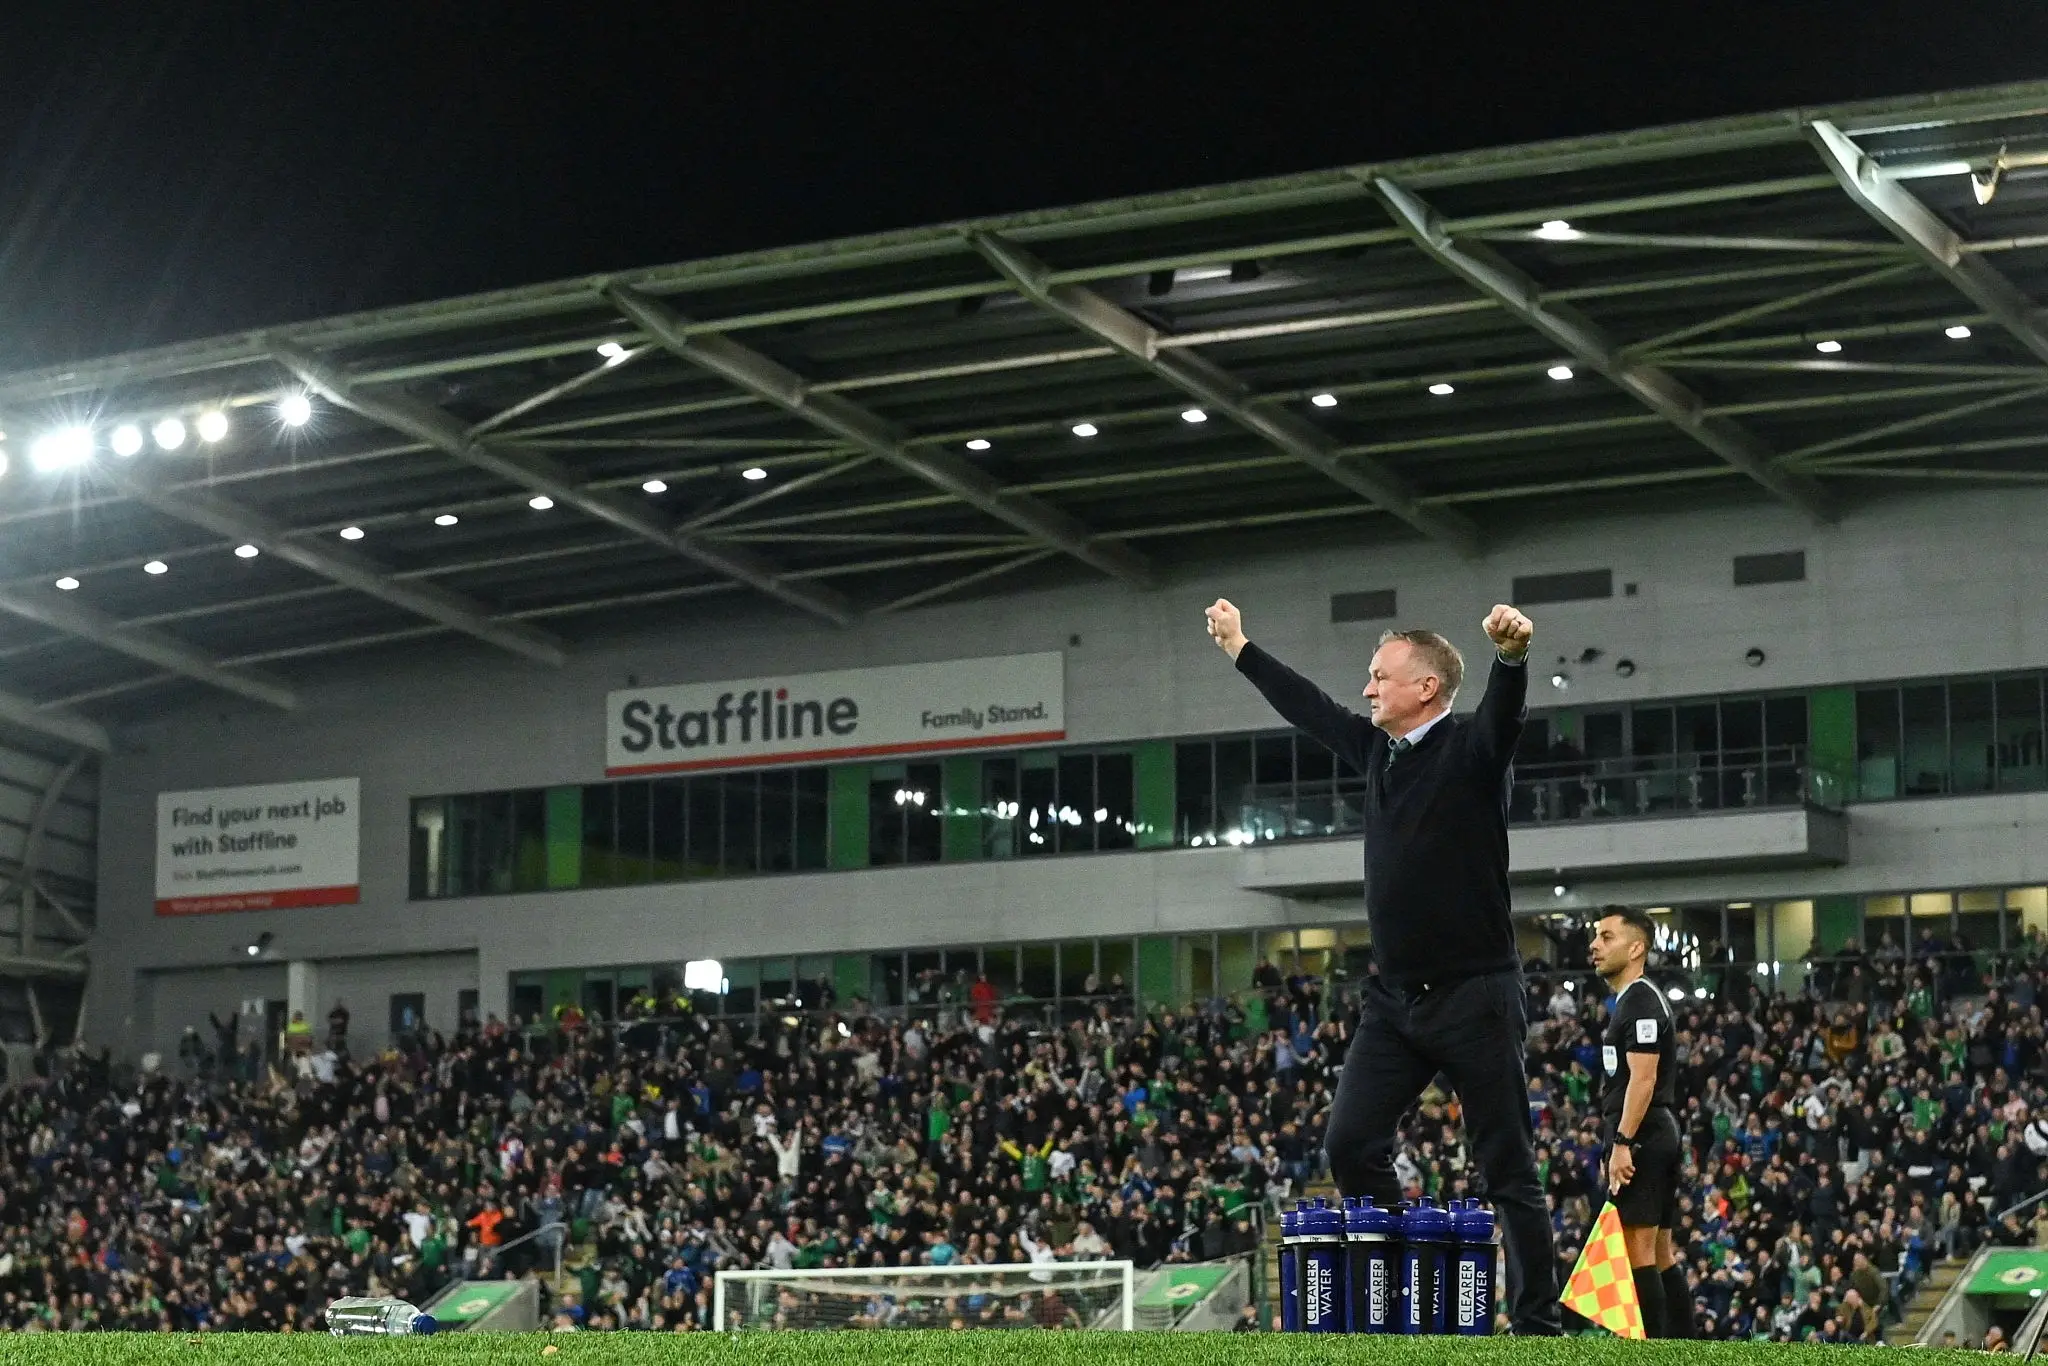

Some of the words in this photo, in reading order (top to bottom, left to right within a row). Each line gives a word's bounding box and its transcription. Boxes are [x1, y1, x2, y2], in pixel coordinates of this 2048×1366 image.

[622, 689, 859, 753] Staffline
[921, 705, 985, 730] Family
[988, 703, 1050, 724] Stand.
[173, 805, 213, 827] Find
[218, 807, 262, 829] your
[267, 800, 310, 820] next
[315, 796, 346, 821] job
[172, 835, 213, 856] with
[1307, 1262, 1317, 1322] CLEARER
[1321, 1268, 1332, 1316] WATER
[1372, 1262, 1383, 1322] CLEARER
[1460, 1264, 1473, 1323] CLEARER
[1475, 1270, 1488, 1318] WATER
